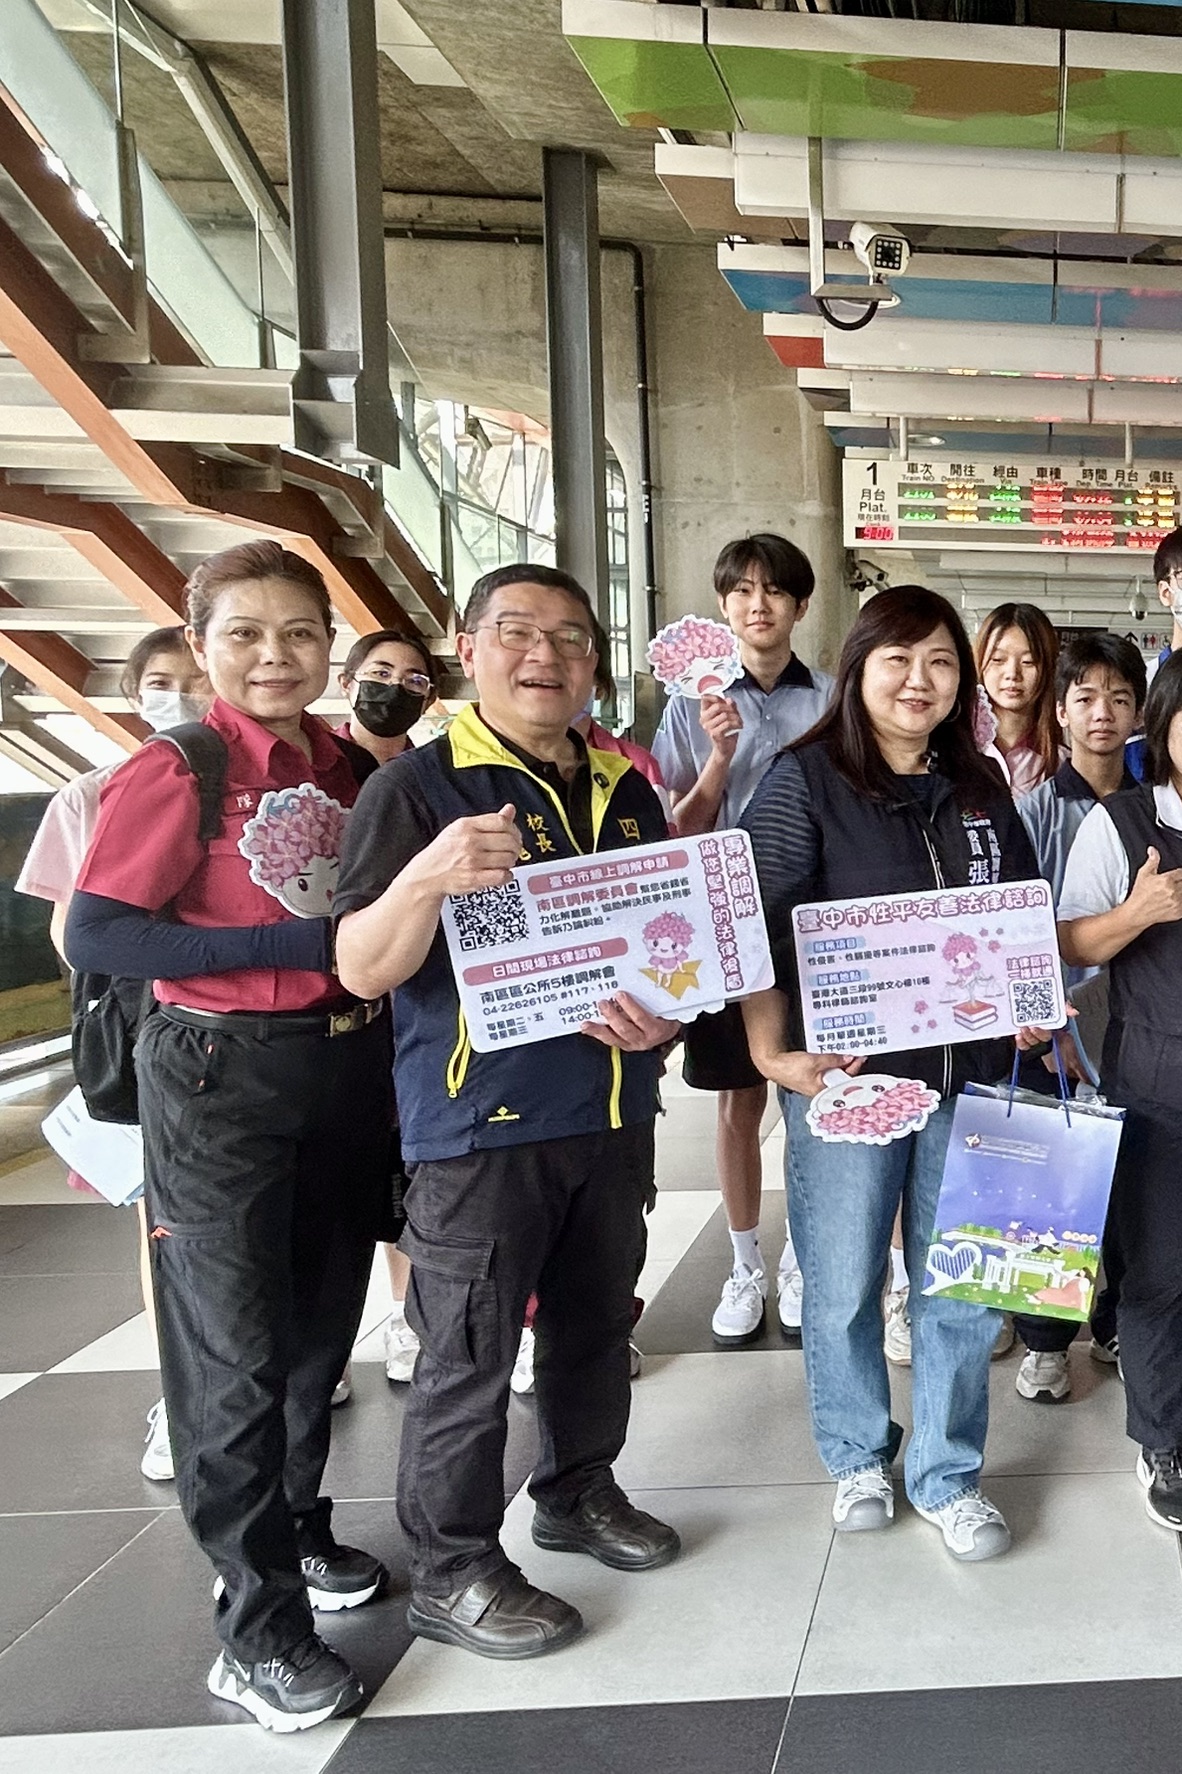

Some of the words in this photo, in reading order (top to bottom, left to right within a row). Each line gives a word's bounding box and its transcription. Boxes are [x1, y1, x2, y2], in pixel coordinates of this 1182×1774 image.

[866, 462, 878, 485] 1
[907, 463, 933, 475] 車次
[950, 464, 976, 477] 開往
[993, 466, 1018, 478] 經由
[1036, 467, 1061, 480] 車種
[1082, 469, 1108, 481] 時間
[1115, 469, 1138, 482] 月台
[1149, 470, 1174, 483] 備註
[860, 502, 887, 513] Plat.
[861, 489, 886, 501] 月台
[525, 812, 557, 853] 校長
[722, 834, 759, 919] 專業調解
[968, 859, 990, 885] 張
[536, 882, 638, 912] 南區調解委員會
[797, 886, 1048, 933] 臺中市性平友善法律諮詢
[492, 945, 602, 978] 日間現場法律諮詢
[479, 965, 616, 1004] 南區區公所5樓調解會
[482, 995, 558, 1016] 04-22626105
